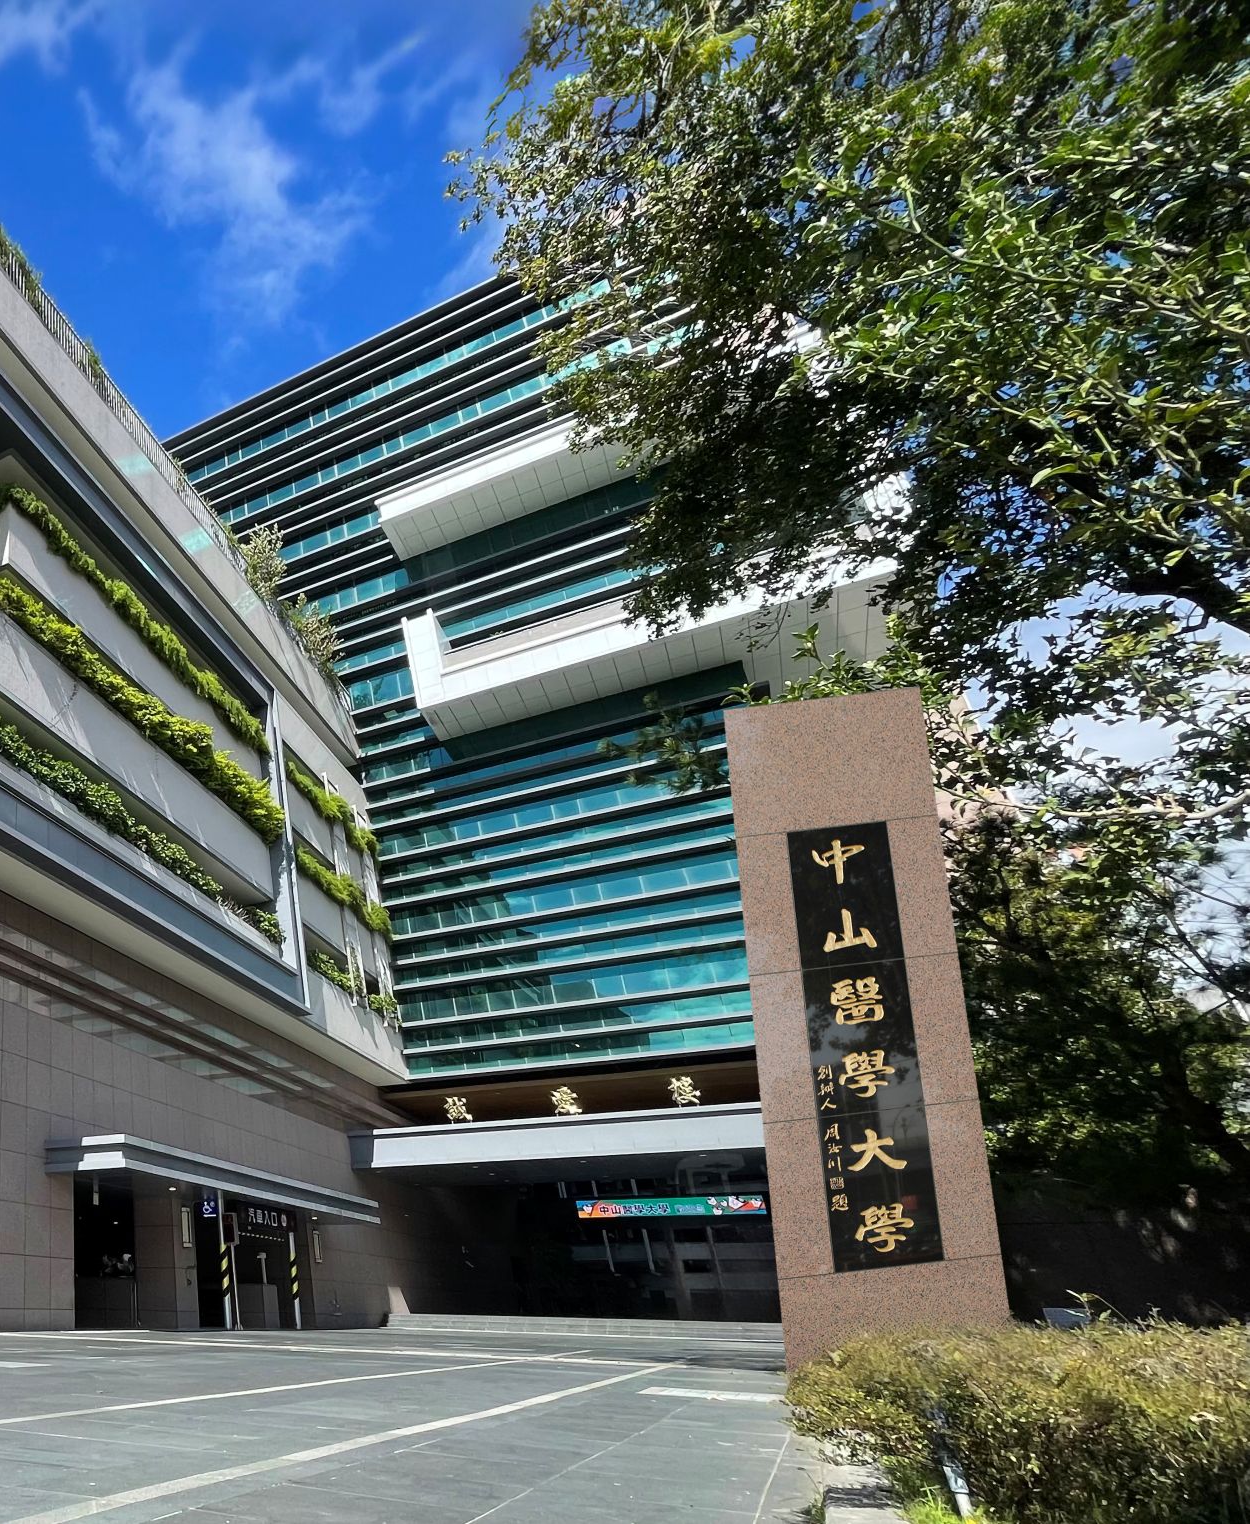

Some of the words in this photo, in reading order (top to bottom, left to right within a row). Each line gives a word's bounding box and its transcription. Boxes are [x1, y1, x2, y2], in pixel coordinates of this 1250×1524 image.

[811, 838, 915, 1253] 中山醫學大學
[247, 1207, 278, 1227] 汽車入口
[599, 1203, 670, 1215] 中山醫學大學
